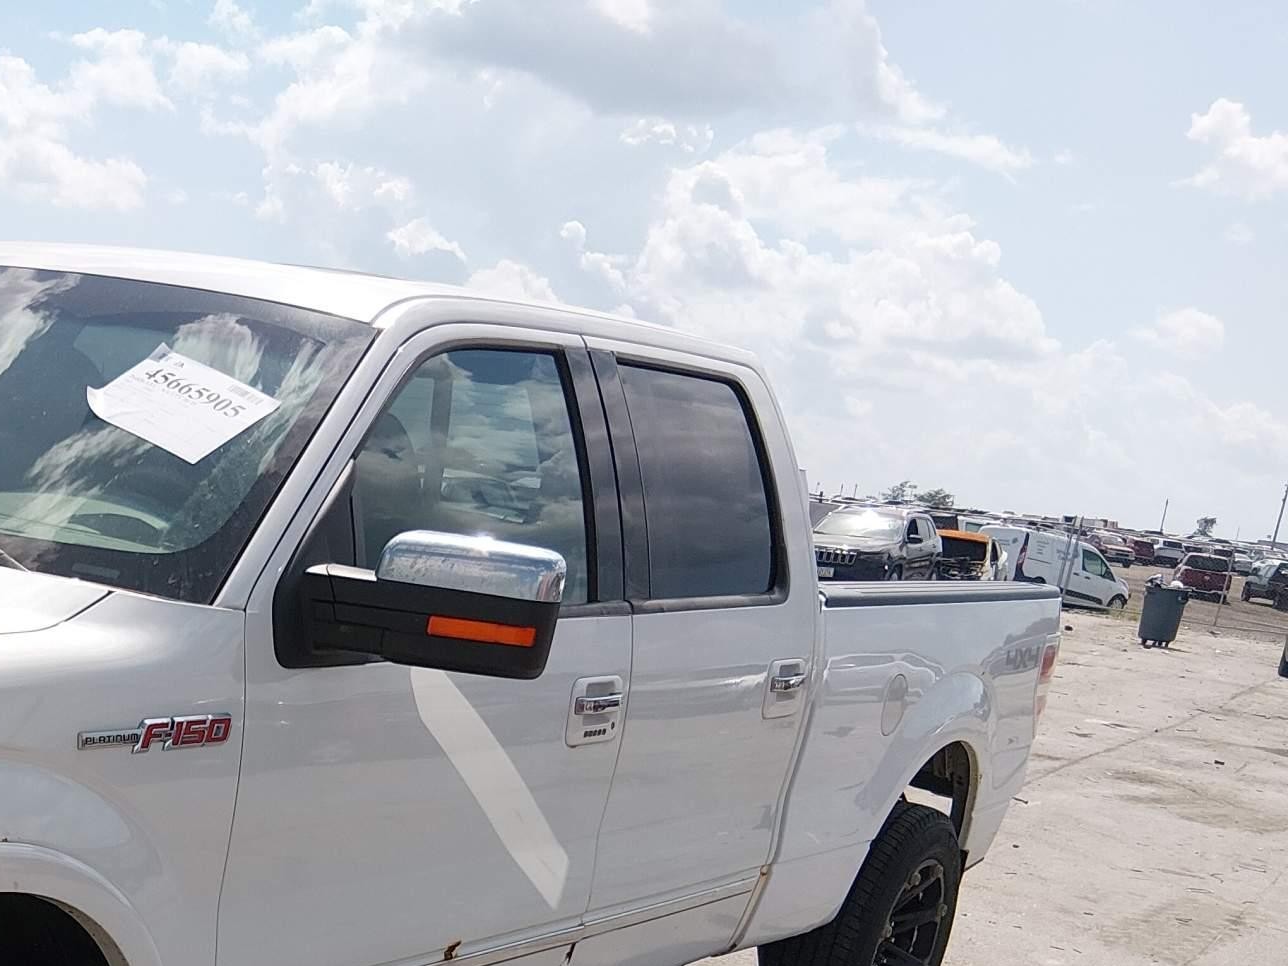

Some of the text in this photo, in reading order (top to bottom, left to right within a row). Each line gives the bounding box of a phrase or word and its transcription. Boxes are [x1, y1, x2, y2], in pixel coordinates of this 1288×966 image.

[144, 368, 247, 418] 45665905
[85, 713, 232, 752] PLATINUM F-150
